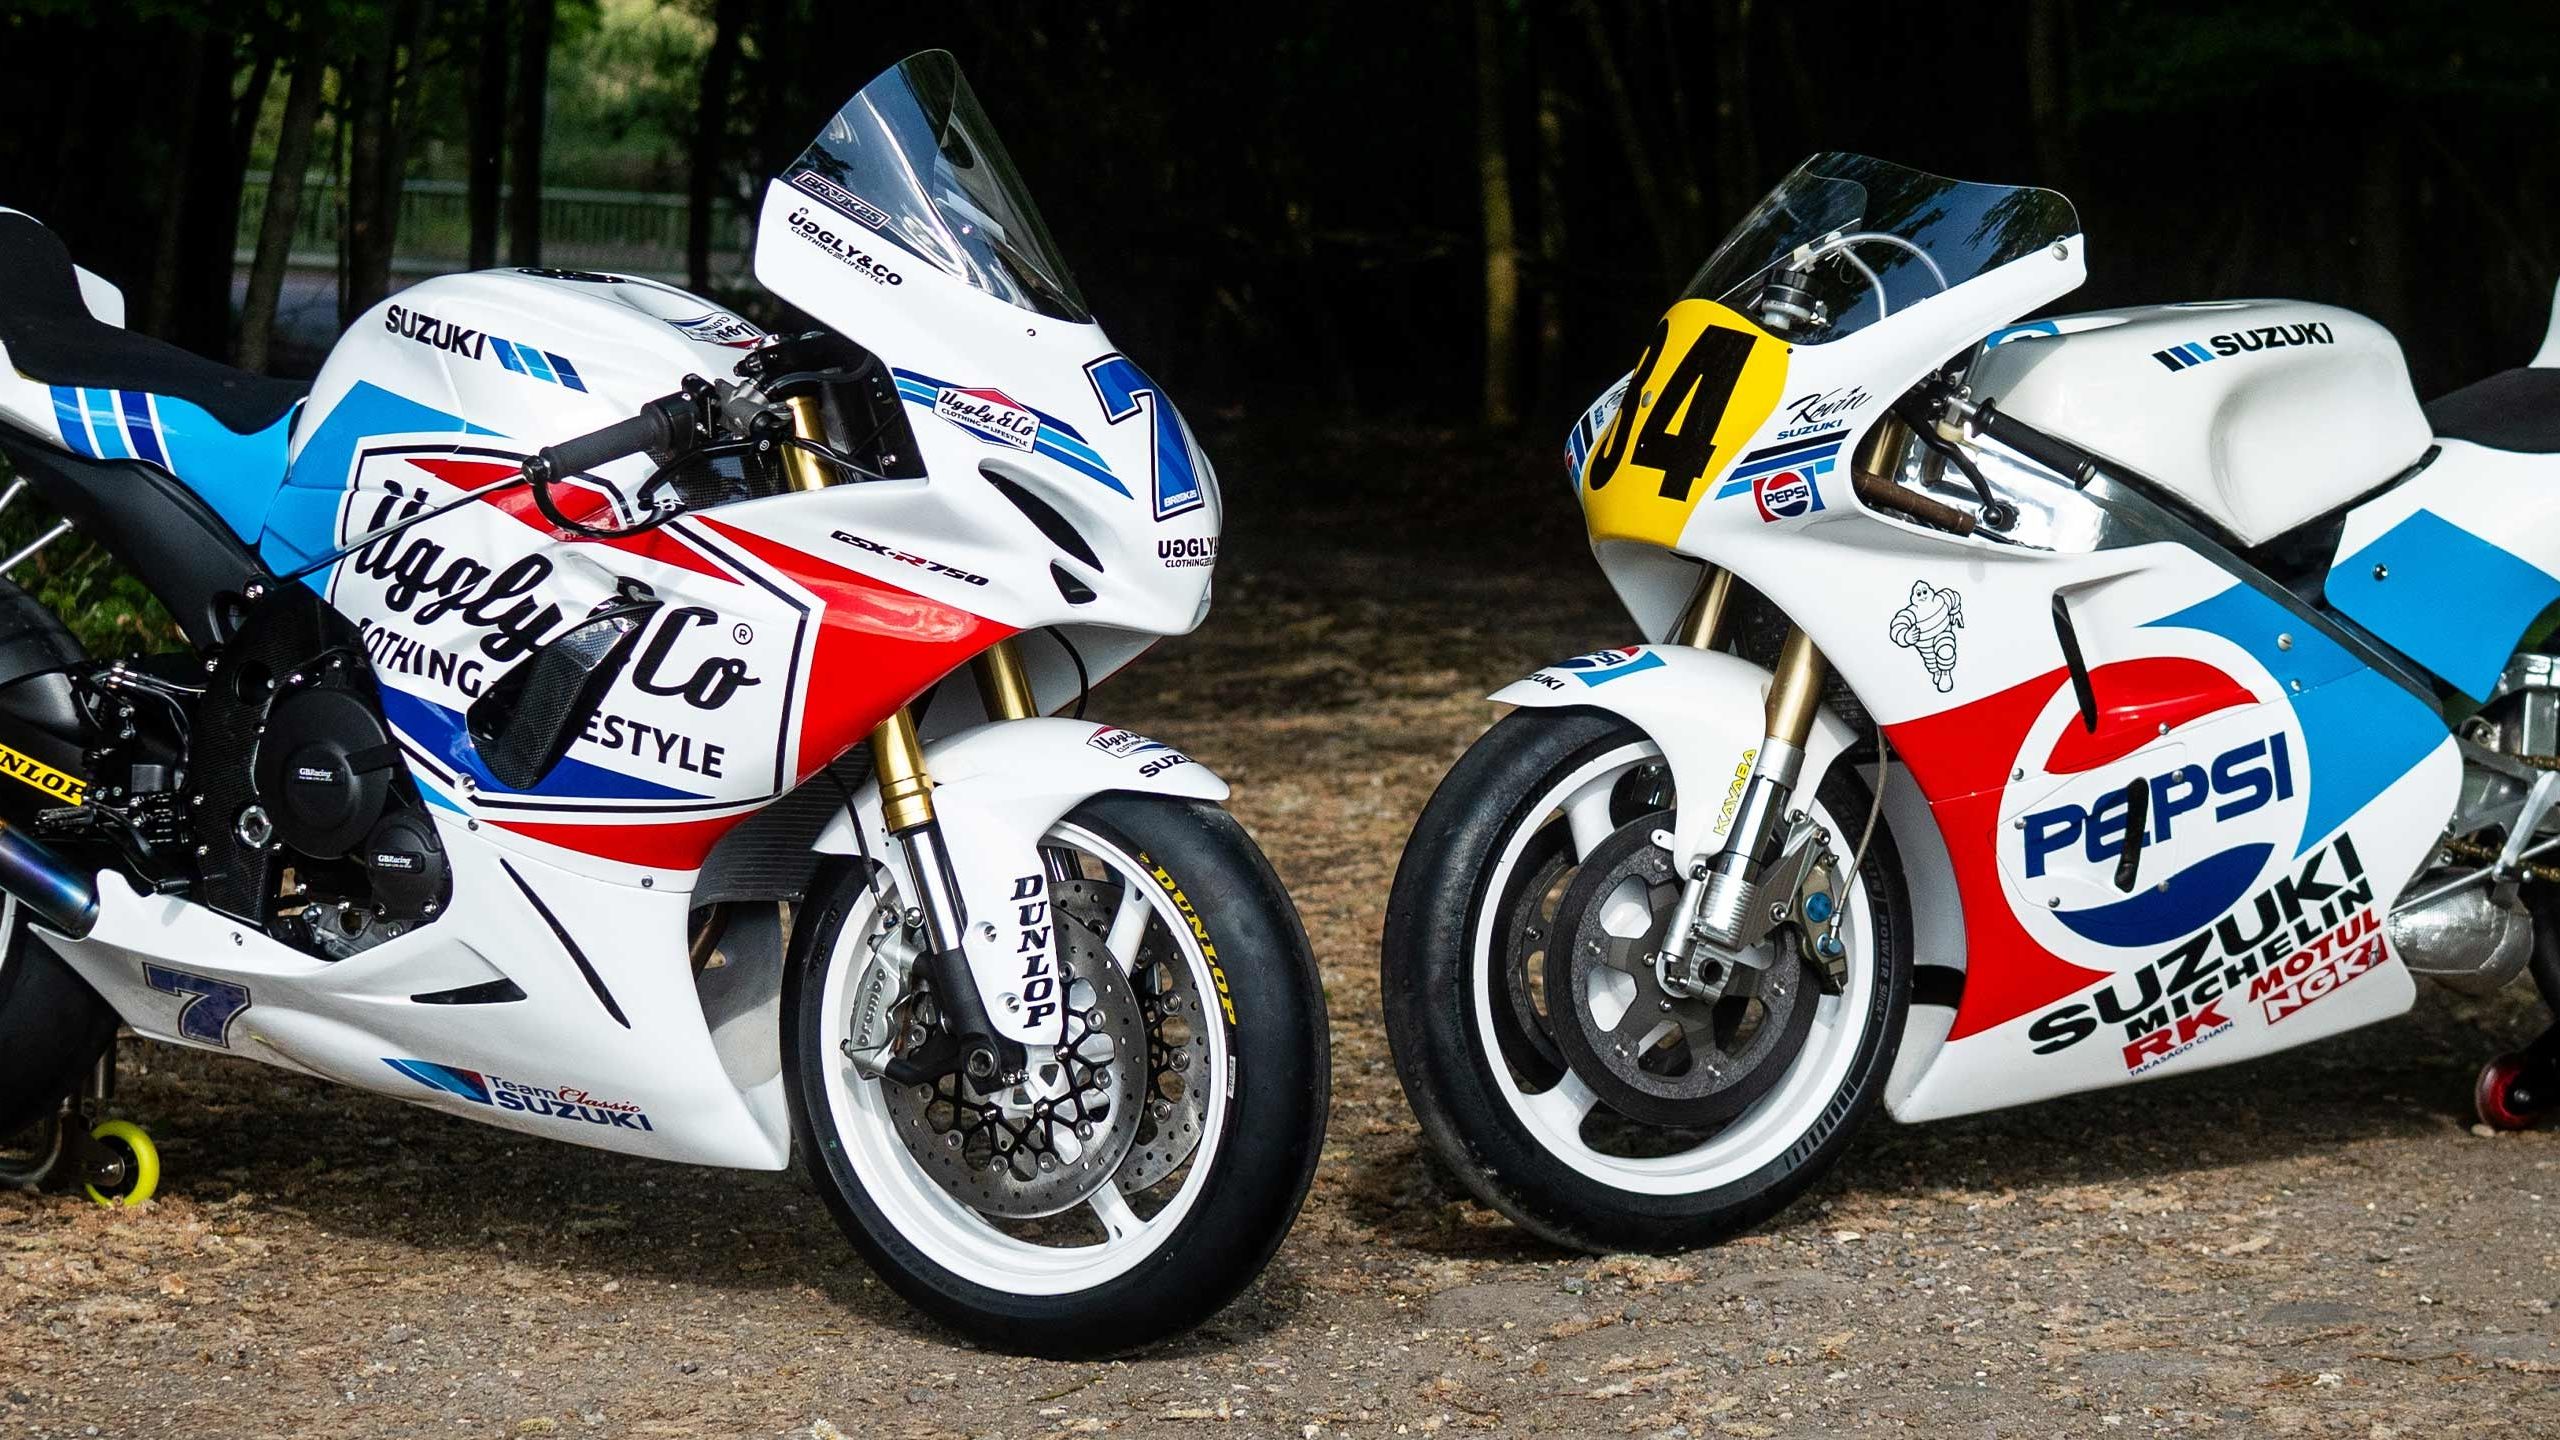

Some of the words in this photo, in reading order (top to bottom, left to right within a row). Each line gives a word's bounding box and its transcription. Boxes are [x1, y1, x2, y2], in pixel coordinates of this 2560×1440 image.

[791, 226, 834, 255] CLOTHING
[843, 258, 886, 286] LIFESTYLE
[385, 304, 487, 360] SUZUKI
[2210, 323, 2334, 356] SUZUKI
[939, 391, 996, 423] Uggly
[941, 408, 982, 426] CLOTHING
[990, 426, 1028, 447] LIFESTYLE
[1082, 353, 1205, 522] 7
[1777, 419, 1843, 440] SUZUKI
[1786, 386, 1873, 425] Kevin
[1764, 485, 1809, 507] PEPSI
[355, 480, 563, 662] Uggly
[580, 709, 725, 779] ESTYLE
[1713, 748, 1757, 836] KAYABA
[2024, 731, 2294, 879] PEPSI
[1010, 873, 1056, 1029] DUNLOP
[1150, 866, 1237, 1026] DUNLOP
[2027, 831, 2365, 1056] SUZUKI
[2124, 876, 2374, 1042] MICHELIN
[2249, 907, 2381, 1003] MOTUL
[142, 961, 252, 1049] 7
[2264, 946, 2370, 1023] NGK
[2122, 997, 2231, 1070] RK
[2129, 1042, 2194, 1077] TAKASAGO
[2196, 1021, 2234, 1045] CHAIN
[485, 1074, 558, 1100] Team
[558, 1085, 642, 1113] Classic
[495, 1090, 654, 1132] SUZUKI
